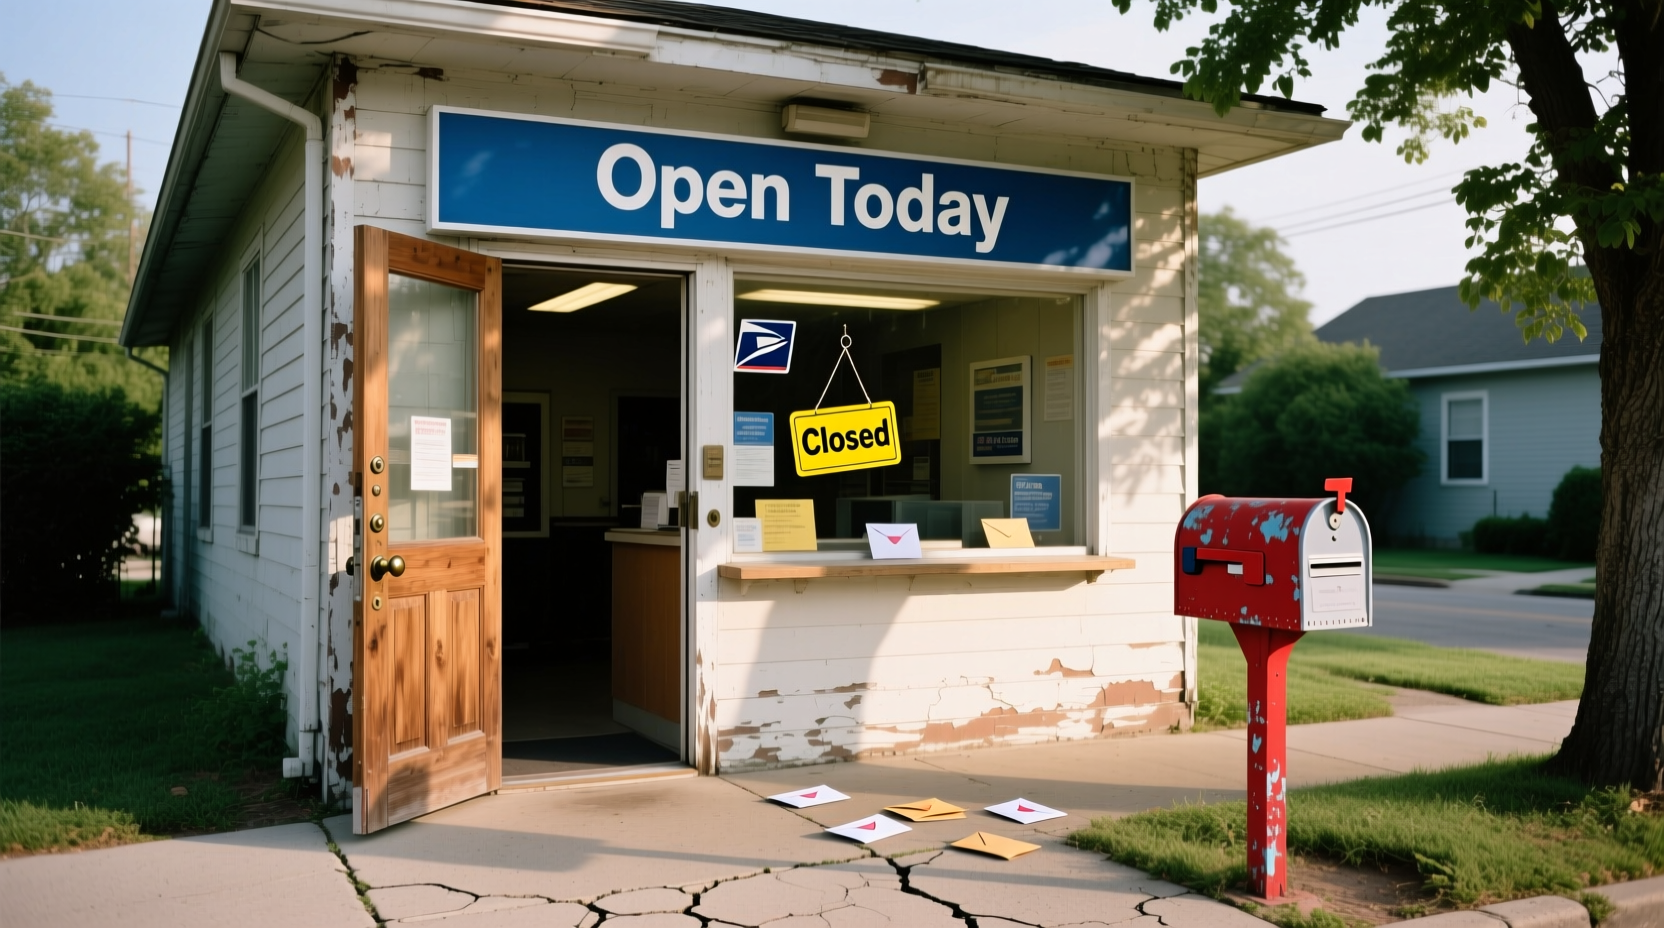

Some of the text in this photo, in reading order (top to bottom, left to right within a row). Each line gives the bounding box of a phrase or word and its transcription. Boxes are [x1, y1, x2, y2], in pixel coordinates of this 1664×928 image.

[597, 143, 1010, 253] Open Today
[801, 417, 890, 456] Closed
